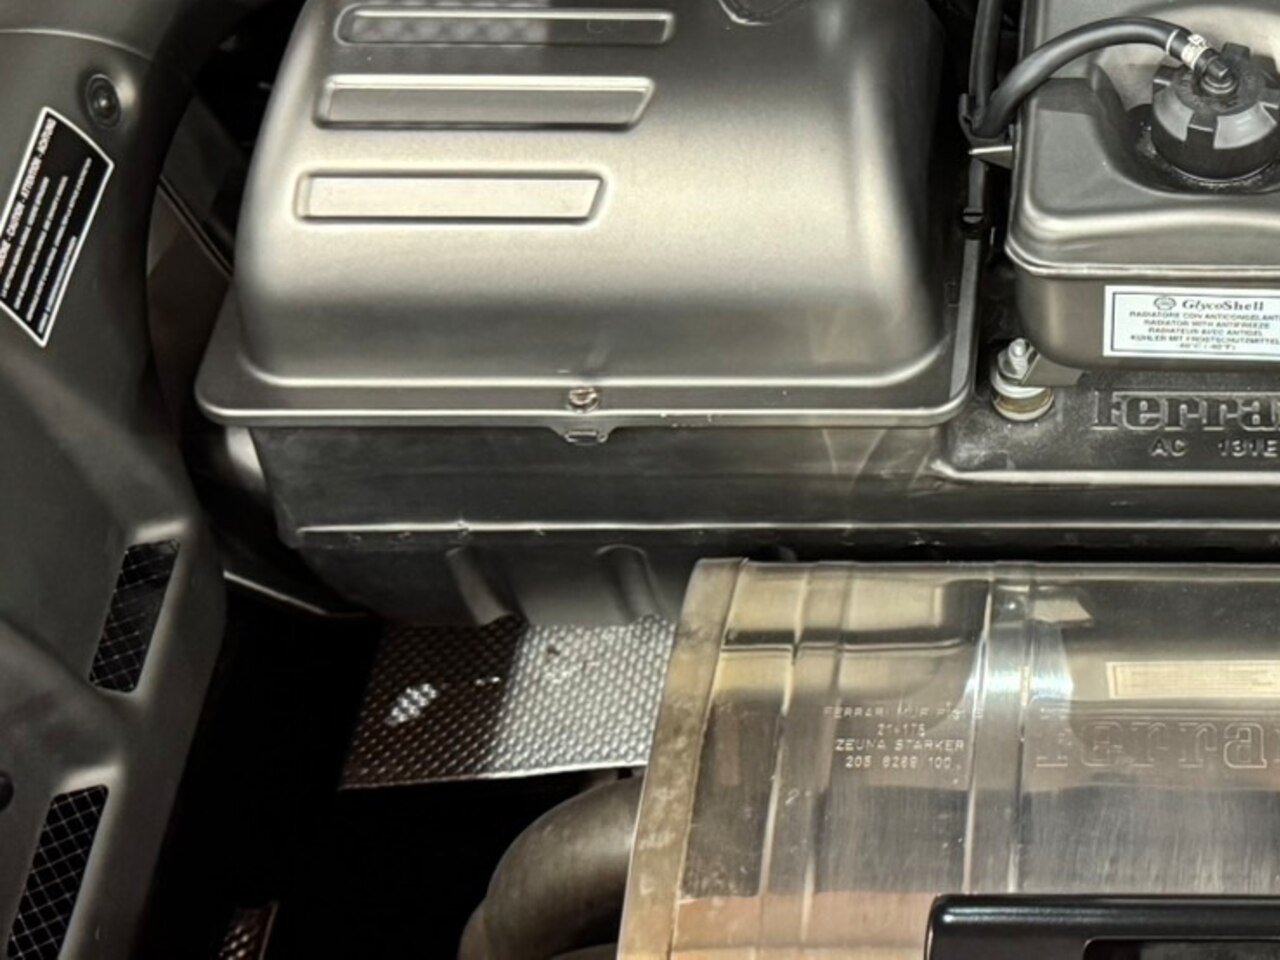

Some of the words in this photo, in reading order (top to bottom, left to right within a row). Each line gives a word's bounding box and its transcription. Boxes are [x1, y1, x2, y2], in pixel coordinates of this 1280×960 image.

[1182, 298, 1265, 312] GlycoShell
[1150, 438, 1188, 457] AC
[834, 738, 886, 751] ZEUNA
